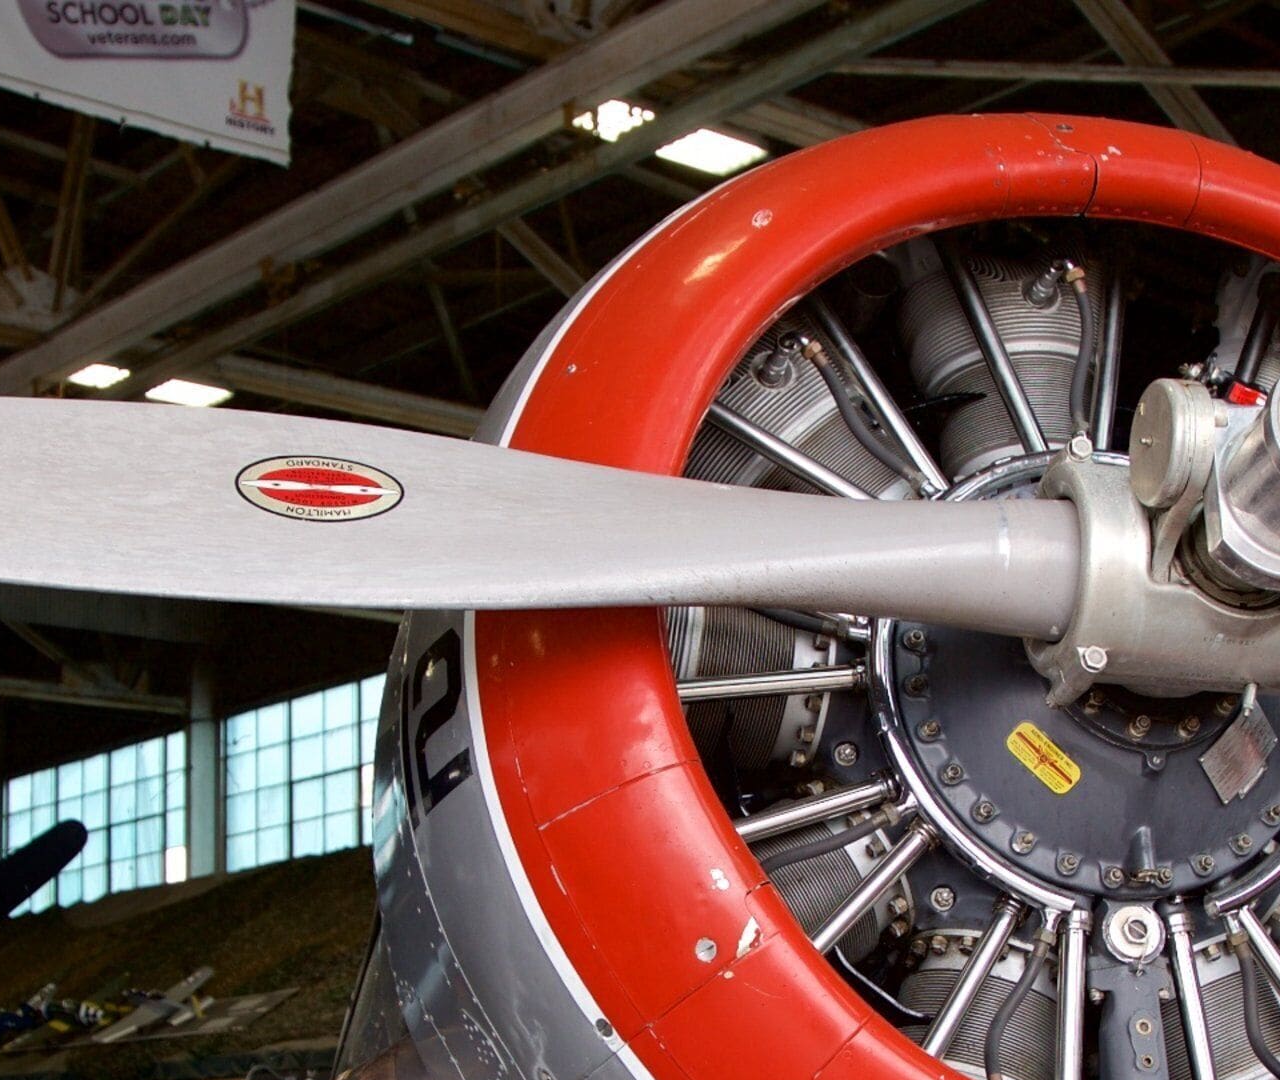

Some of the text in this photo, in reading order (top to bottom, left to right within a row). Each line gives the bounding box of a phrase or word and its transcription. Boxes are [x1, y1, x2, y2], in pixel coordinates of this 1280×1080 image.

[47, 1, 214, 28] SCHOOL DAY
[87, 31, 197, 47] veterans.com
[285, 457, 354, 472] STANDARD
[285, 505, 352, 517] HAMILTON
